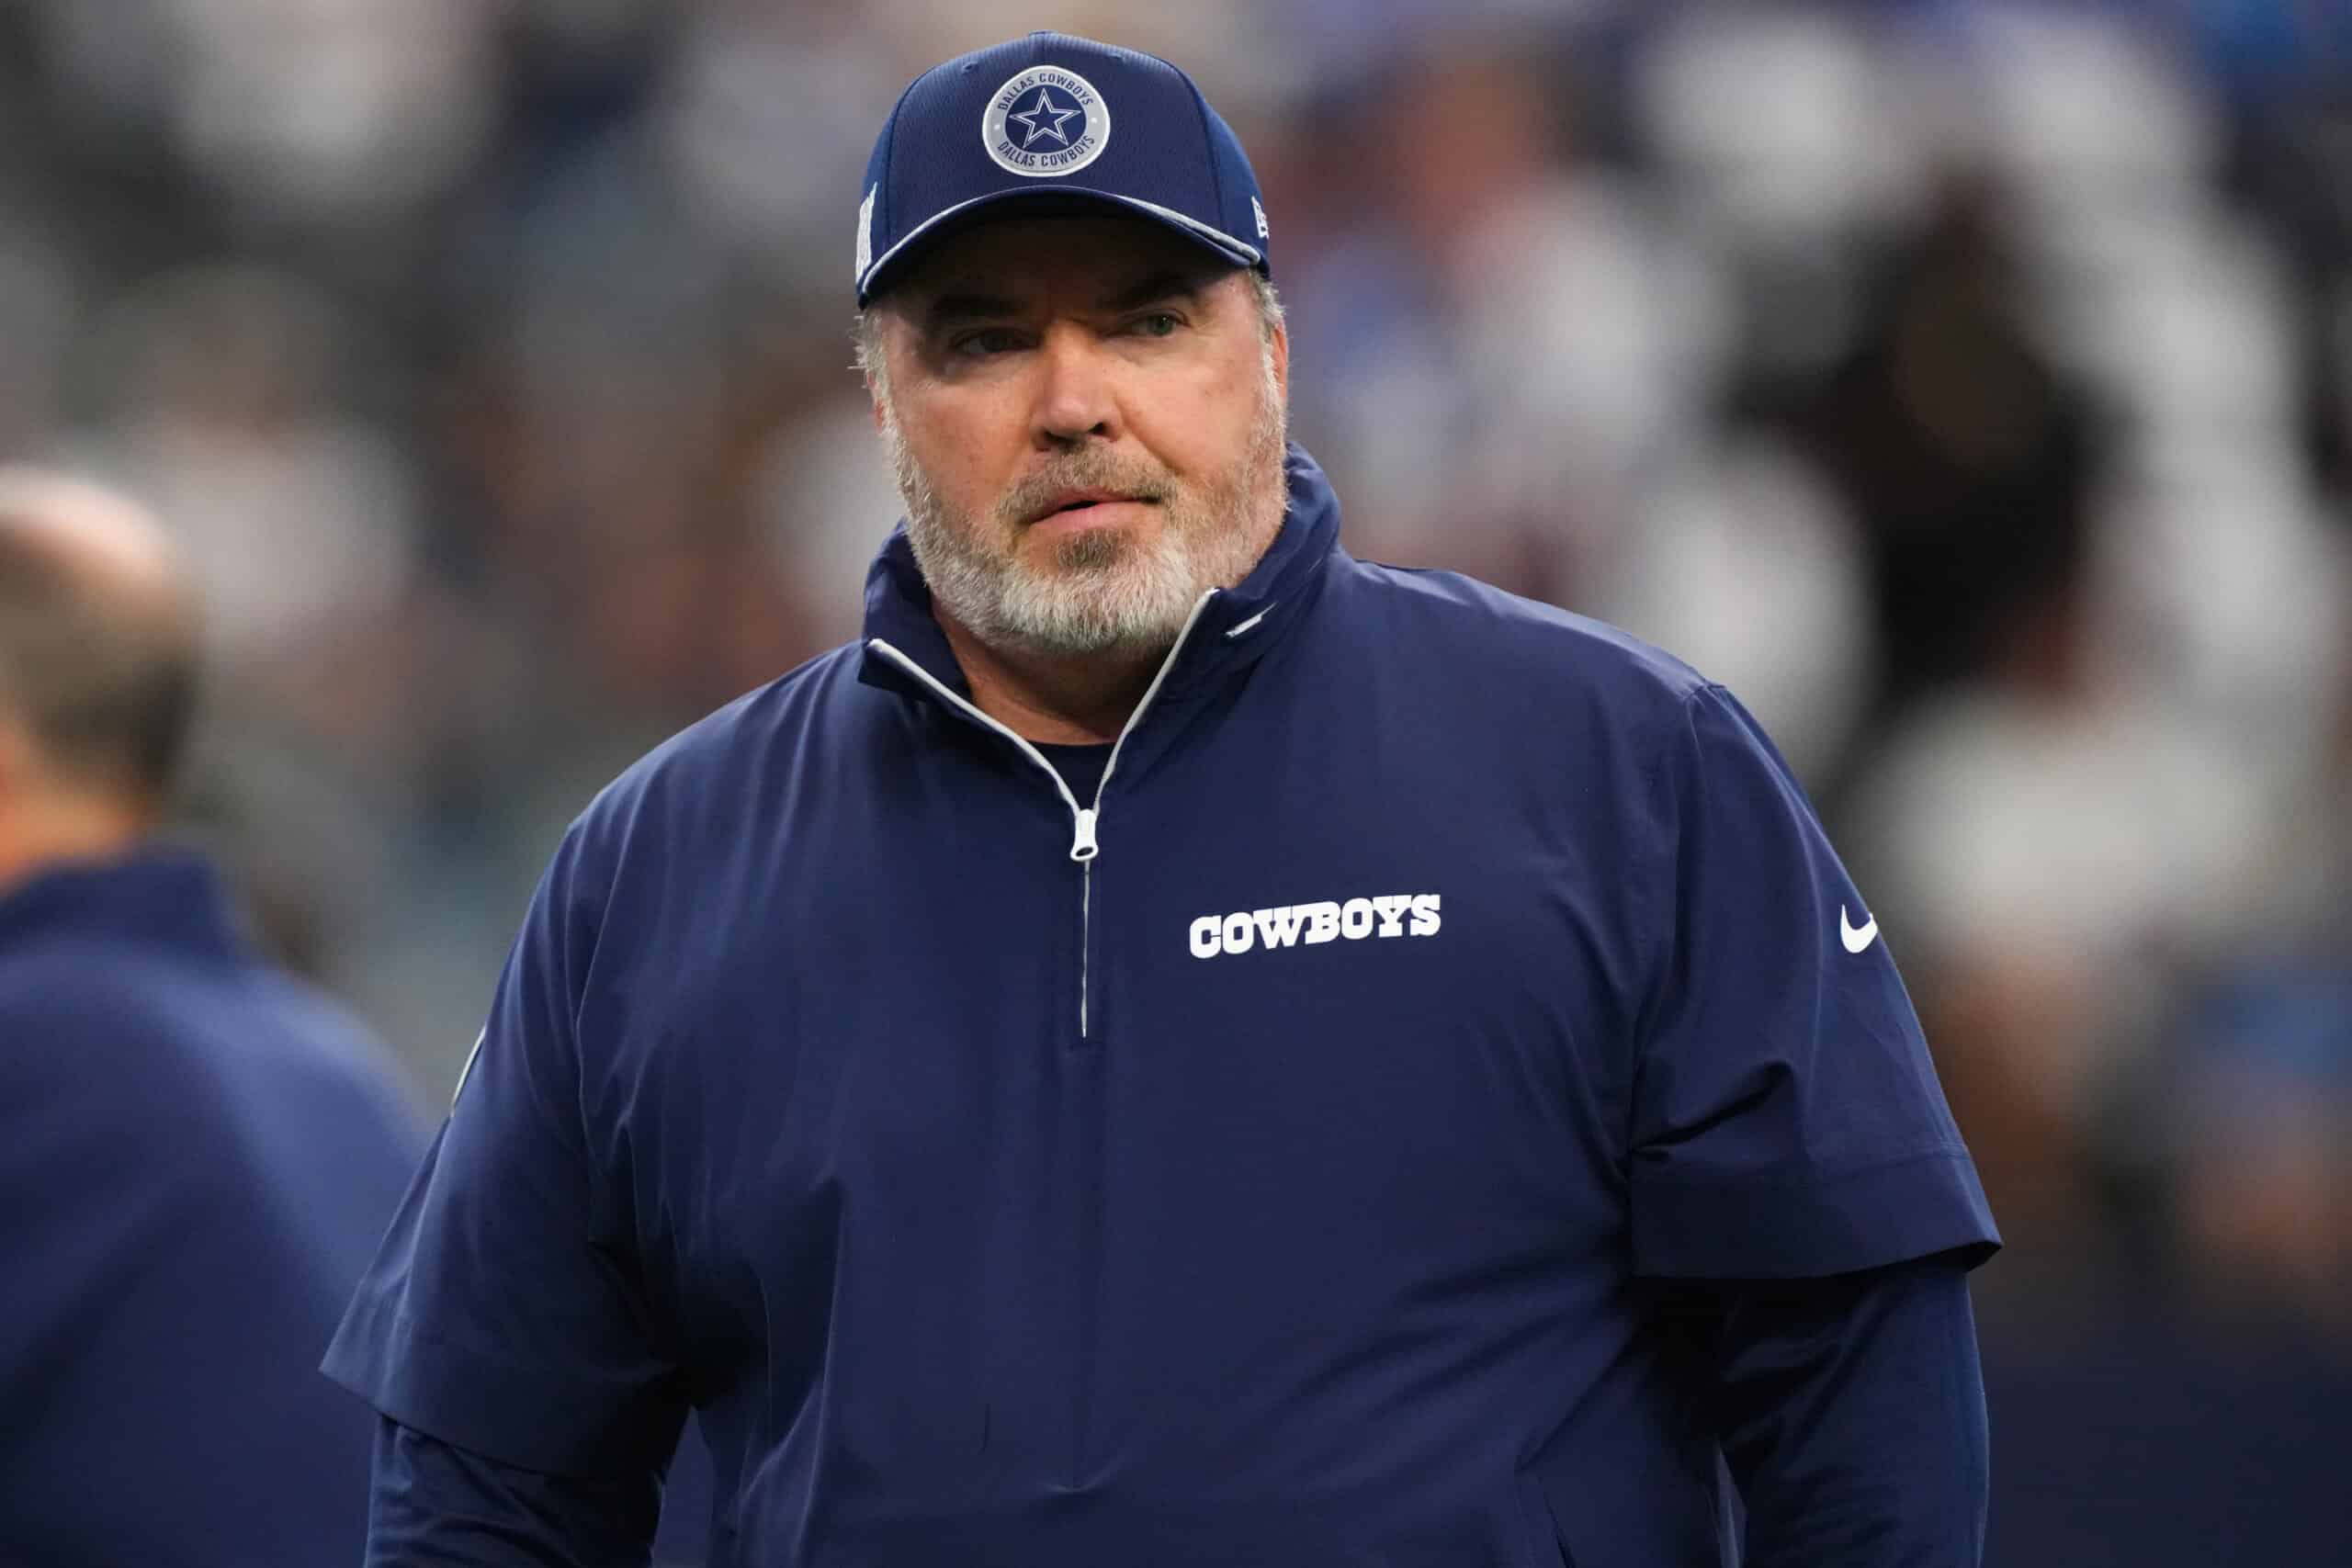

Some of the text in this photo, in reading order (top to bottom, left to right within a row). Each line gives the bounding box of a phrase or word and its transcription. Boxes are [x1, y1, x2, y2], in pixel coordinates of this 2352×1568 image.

[998, 73, 1094, 111] DALLAS COWBOYS
[997, 134, 1096, 167] DALLAS COWBOYS
[1189, 893, 1442, 960] COWBOYS
